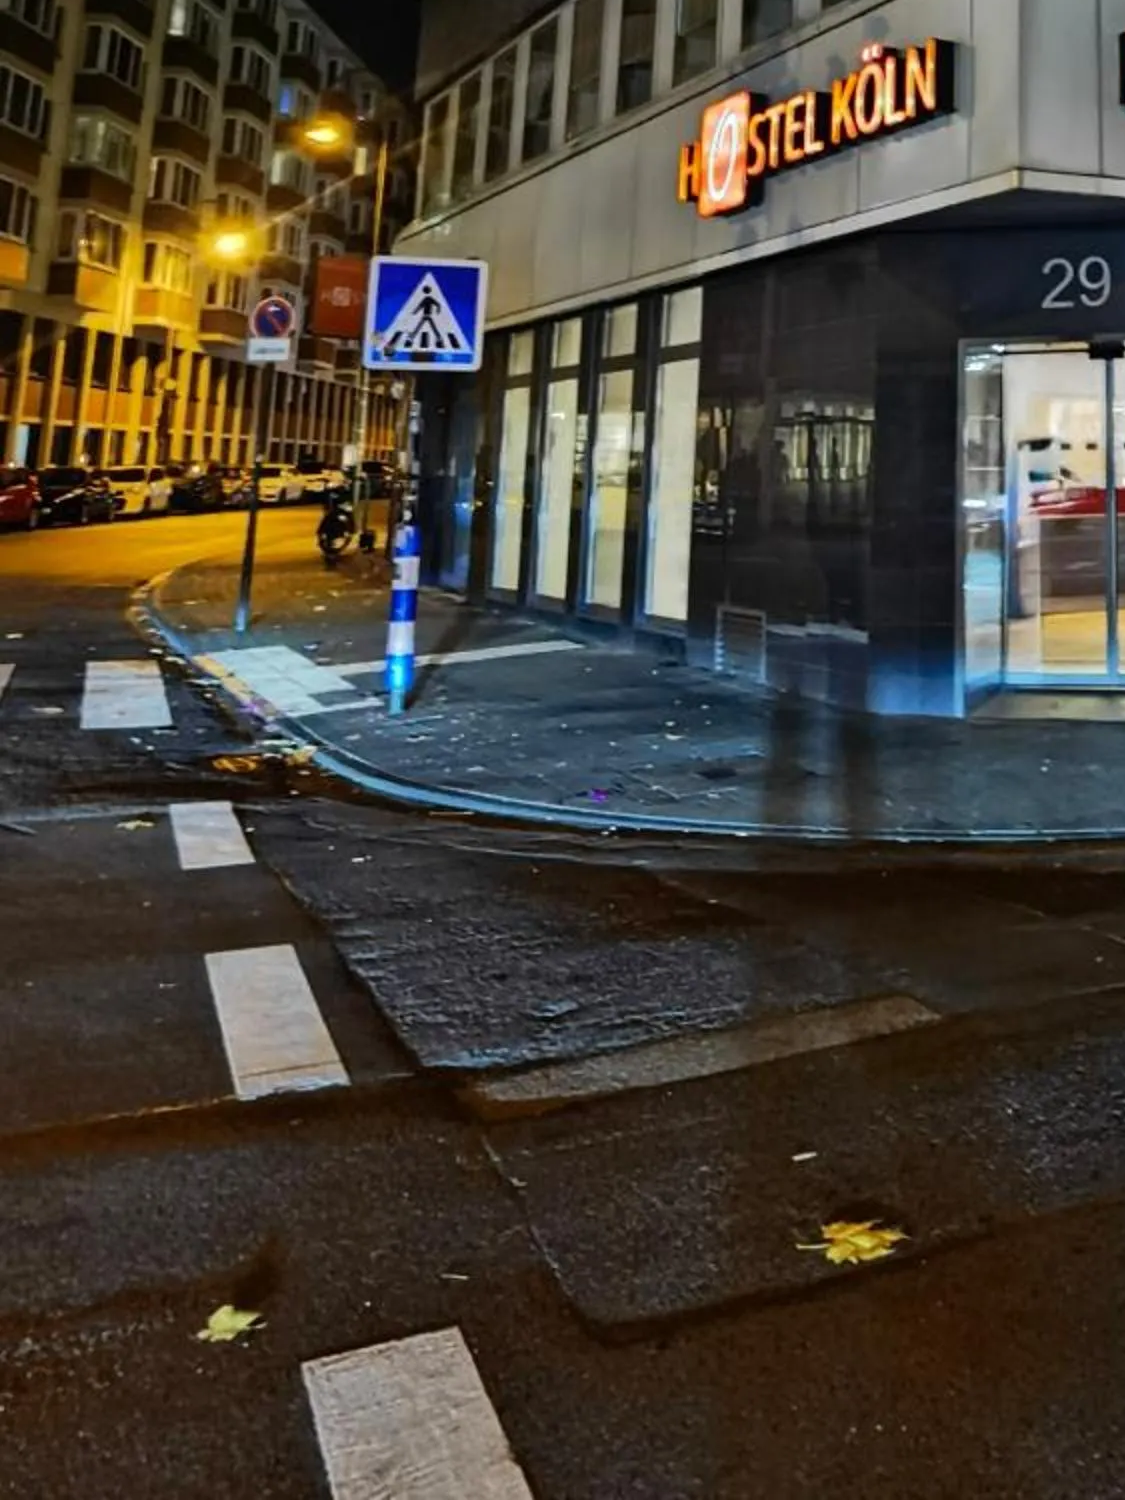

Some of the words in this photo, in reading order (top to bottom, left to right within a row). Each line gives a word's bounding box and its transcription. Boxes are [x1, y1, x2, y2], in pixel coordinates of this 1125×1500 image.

[677, 91, 825, 208] HOSTEL
[831, 37, 937, 143] KÖLN
[1042, 256, 1111, 308] 29
